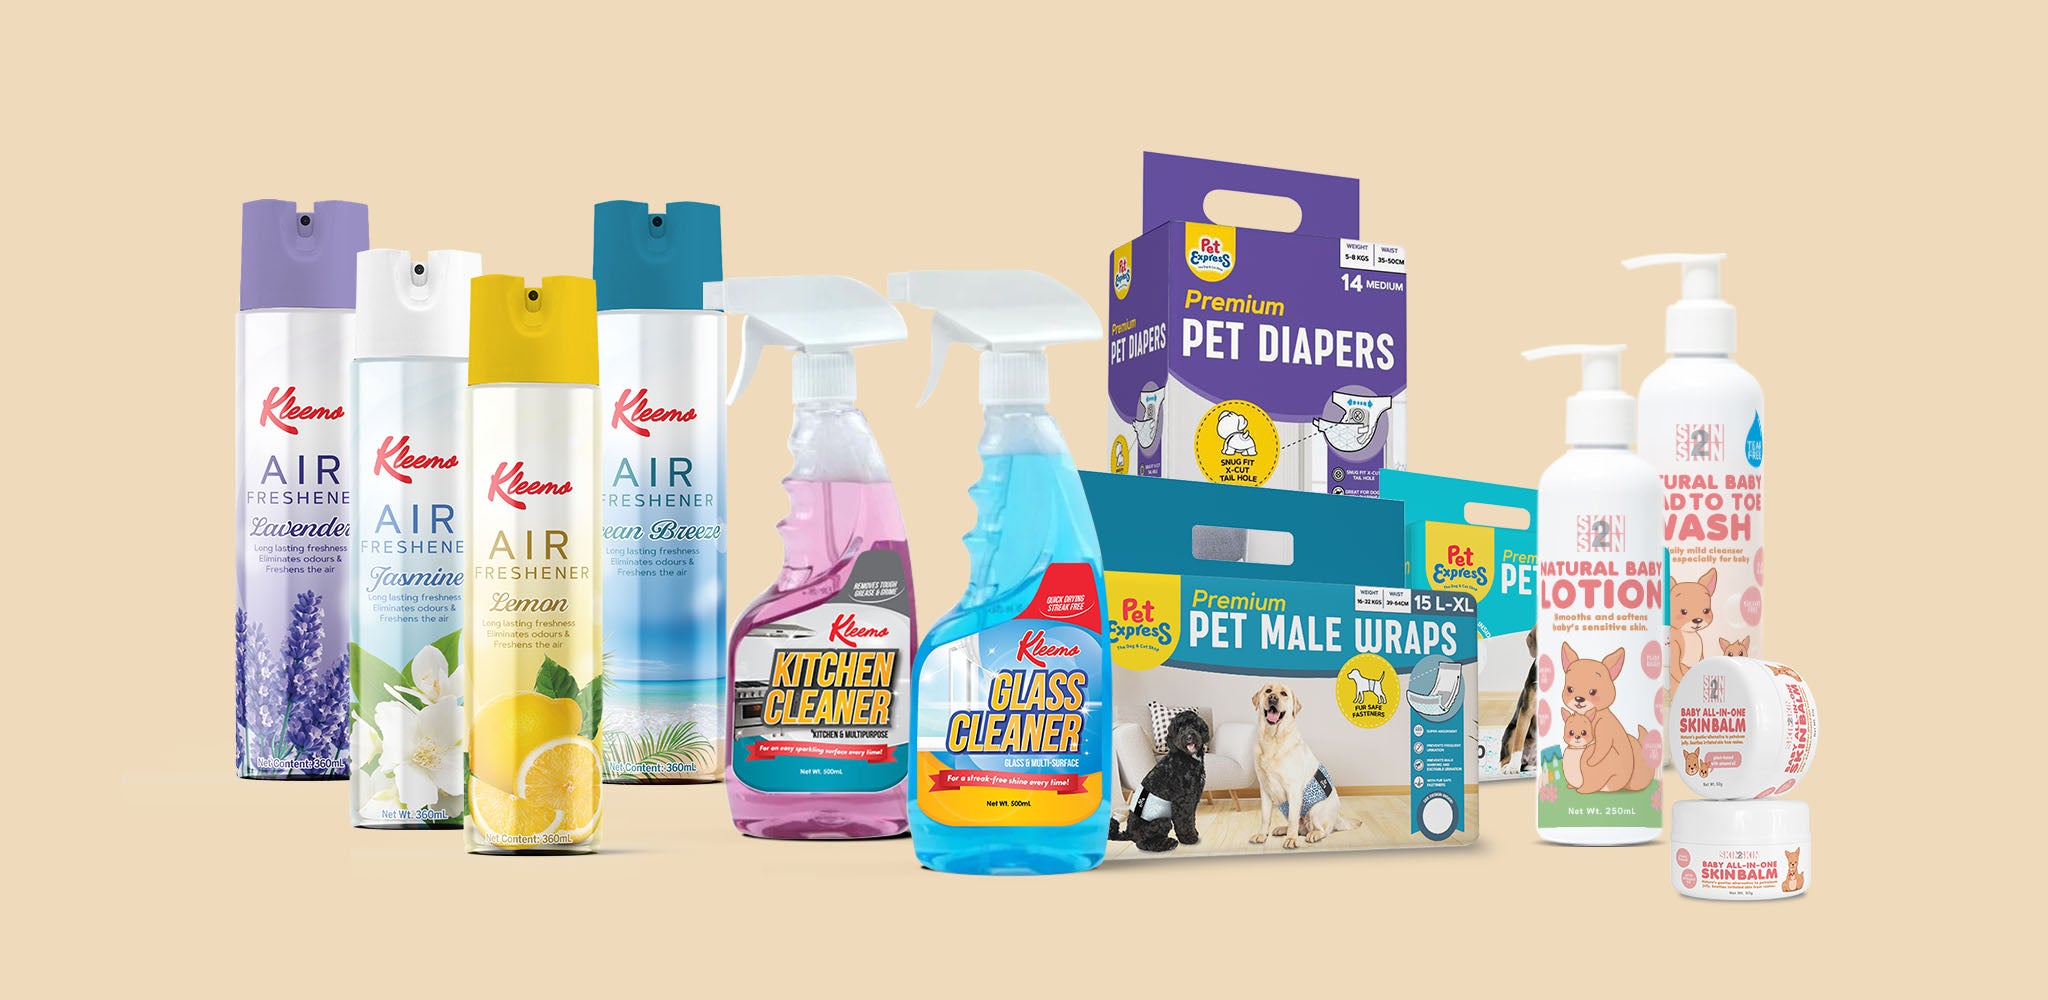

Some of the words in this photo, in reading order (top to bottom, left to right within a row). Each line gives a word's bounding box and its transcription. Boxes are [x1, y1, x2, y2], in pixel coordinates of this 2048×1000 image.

[1200, 238, 1221, 254] Pet
[1346, 243, 1368, 251] WEIGHT
[1345, 253, 1356, 261] 5-8
[1377, 256, 1405, 265] 35-50CM
[1340, 273, 1363, 292] 14
[1366, 279, 1404, 292] MEDIUM
[1184, 289, 1285, 317] Premium
[1112, 319, 1137, 336] Premium
[1111, 337, 1126, 365] PET
[1128, 322, 1167, 360] DIAPERS
[1182, 317, 1245, 361] PET
[1259, 323, 1395, 371] DIAPERS
[259, 386, 345, 435] Kleemo
[611, 388, 697, 437] Kleemo
[373, 435, 459, 484] Kleemo
[1220, 459, 1241, 467] SNUG
[260, 455, 341, 485] AIR
[612, 457, 693, 487] AIR
[487, 461, 573, 511] Kleemo
[247, 491, 350, 505] FRESHENE
[1689, 493, 1724, 511] TO
[1731, 493, 1762, 511] TOE
[374, 504, 455, 534] AIR
[649, 519, 722, 541] Breeze
[254, 544, 273, 554] Long
[274, 543, 305, 554] lasting
[307, 543, 348, 552] freshness
[361, 540, 464, 554] FRESHENE
[488, 530, 569, 560] AIR
[605, 547, 625, 557] Long
[626, 547, 657, 557] lasting
[659, 547, 700, 555] freshness
[258, 554, 302, 563] Eliminates
[303, 554, 335, 563] odours
[336, 555, 342, 563] &
[610, 558, 653, 566] Eliminates
[655, 558, 687, 566] odours
[689, 558, 695, 566] &
[1447, 544, 1474, 567] Pet
[1672, 556, 1717, 565] especially
[1719, 556, 1731, 564] for
[265, 565, 305, 573] Freshens
[307, 565, 323, 573] the
[324, 565, 336, 573] air
[475, 566, 589, 580] FRESHENER
[617, 569, 657, 577] Freshens
[659, 569, 674, 577] the
[676, 569, 688, 577] air
[1540, 560, 1619, 577] NATURAL
[1626, 560, 1662, 577] BABY
[366, 566, 464, 593] Jasmine
[368, 593, 387, 603] Long
[388, 593, 418, 603] lasting
[421, 593, 462, 601] freshness
[1046, 595, 1064, 605] QUICK
[1191, 589, 1286, 612] Premium
[1541, 578, 1662, 610] LOTION
[373, 603, 416, 612] Eliminates
[417, 603, 449, 612] odours
[450, 603, 456, 612] &
[489, 592, 569, 613] Lemon
[1047, 603, 1070, 612] STREAK
[1070, 602, 1084, 610] FREE
[1414, 594, 1432, 611] 15
[1435, 596, 1474, 613] L-XL
[1122, 597, 1155, 623] Pet
[1554, 612, 1591, 621] Smooths
[1595, 612, 1614, 621] and
[1616, 612, 1648, 621] softens
[379, 614, 418, 622] Freshens
[421, 614, 436, 622] the
[438, 614, 449, 622] air
[482, 619, 501, 629] Long
[502, 619, 533, 629] lasting
[535, 619, 575, 627] freshness
[487, 630, 529, 638] Eliminates
[531, 630, 563, 638] odours
[564, 630, 570, 638] &
[829, 613, 890, 648] Kleemo
[1189, 610, 1247, 649] PET
[1261, 613, 1342, 652] MALE
[1354, 617, 1457, 656] WRAPS
[1552, 622, 1579, 632] baby's
[1582, 622, 1627, 631] sensitive
[1629, 622, 1648, 631] skin.
[493, 640, 532, 649] Freshens
[535, 640, 550, 649] the
[552, 640, 563, 649] air
[1016, 629, 1081, 668] Kleemo
[772, 651, 895, 688] KITCHEN
[989, 671, 1086, 711] GLASS
[763, 688, 892, 725] CLEANER
[1680, 708, 1700, 717] BABY
[1702, 708, 1746, 717] ALL-IN-ONE
[1352, 710, 1385, 718] FASTENERS
[845, 730, 888, 739] MULTIPURPOSE
[947, 713, 1083, 753] CLEANER
[257, 758, 272, 768] Net
[273, 758, 313, 768] Content:
[313, 758, 345, 768] 360mL
[610, 762, 625, 772] Net
[625, 762, 664, 772] Content:
[666, 762, 696, 772] 360mL
[1004, 758, 1025, 768] GLASS
[1025, 758, 1031, 768] &
[1031, 758, 1080, 768] MULTI-SURFACE
[947, 774, 959, 782] For
[967, 774, 1007, 784] streak-free
[1009, 777, 1027, 785] shine
[1029, 779, 1049, 788] every
[1050, 778, 1070, 787] time!
[381, 809, 397, 819] Net
[398, 809, 414, 819] Wt.
[415, 809, 448, 819] 360mL
[1568, 807, 1583, 815] Net
[1586, 807, 1602, 815] Wt.
[1605, 807, 1636, 815] 250mL
[501, 833, 541, 844] Content:
[542, 833, 572, 844] 360mL
[1702, 860, 1724, 868] BABY
[1726, 860, 1777, 868] ALL-IN-ONE
